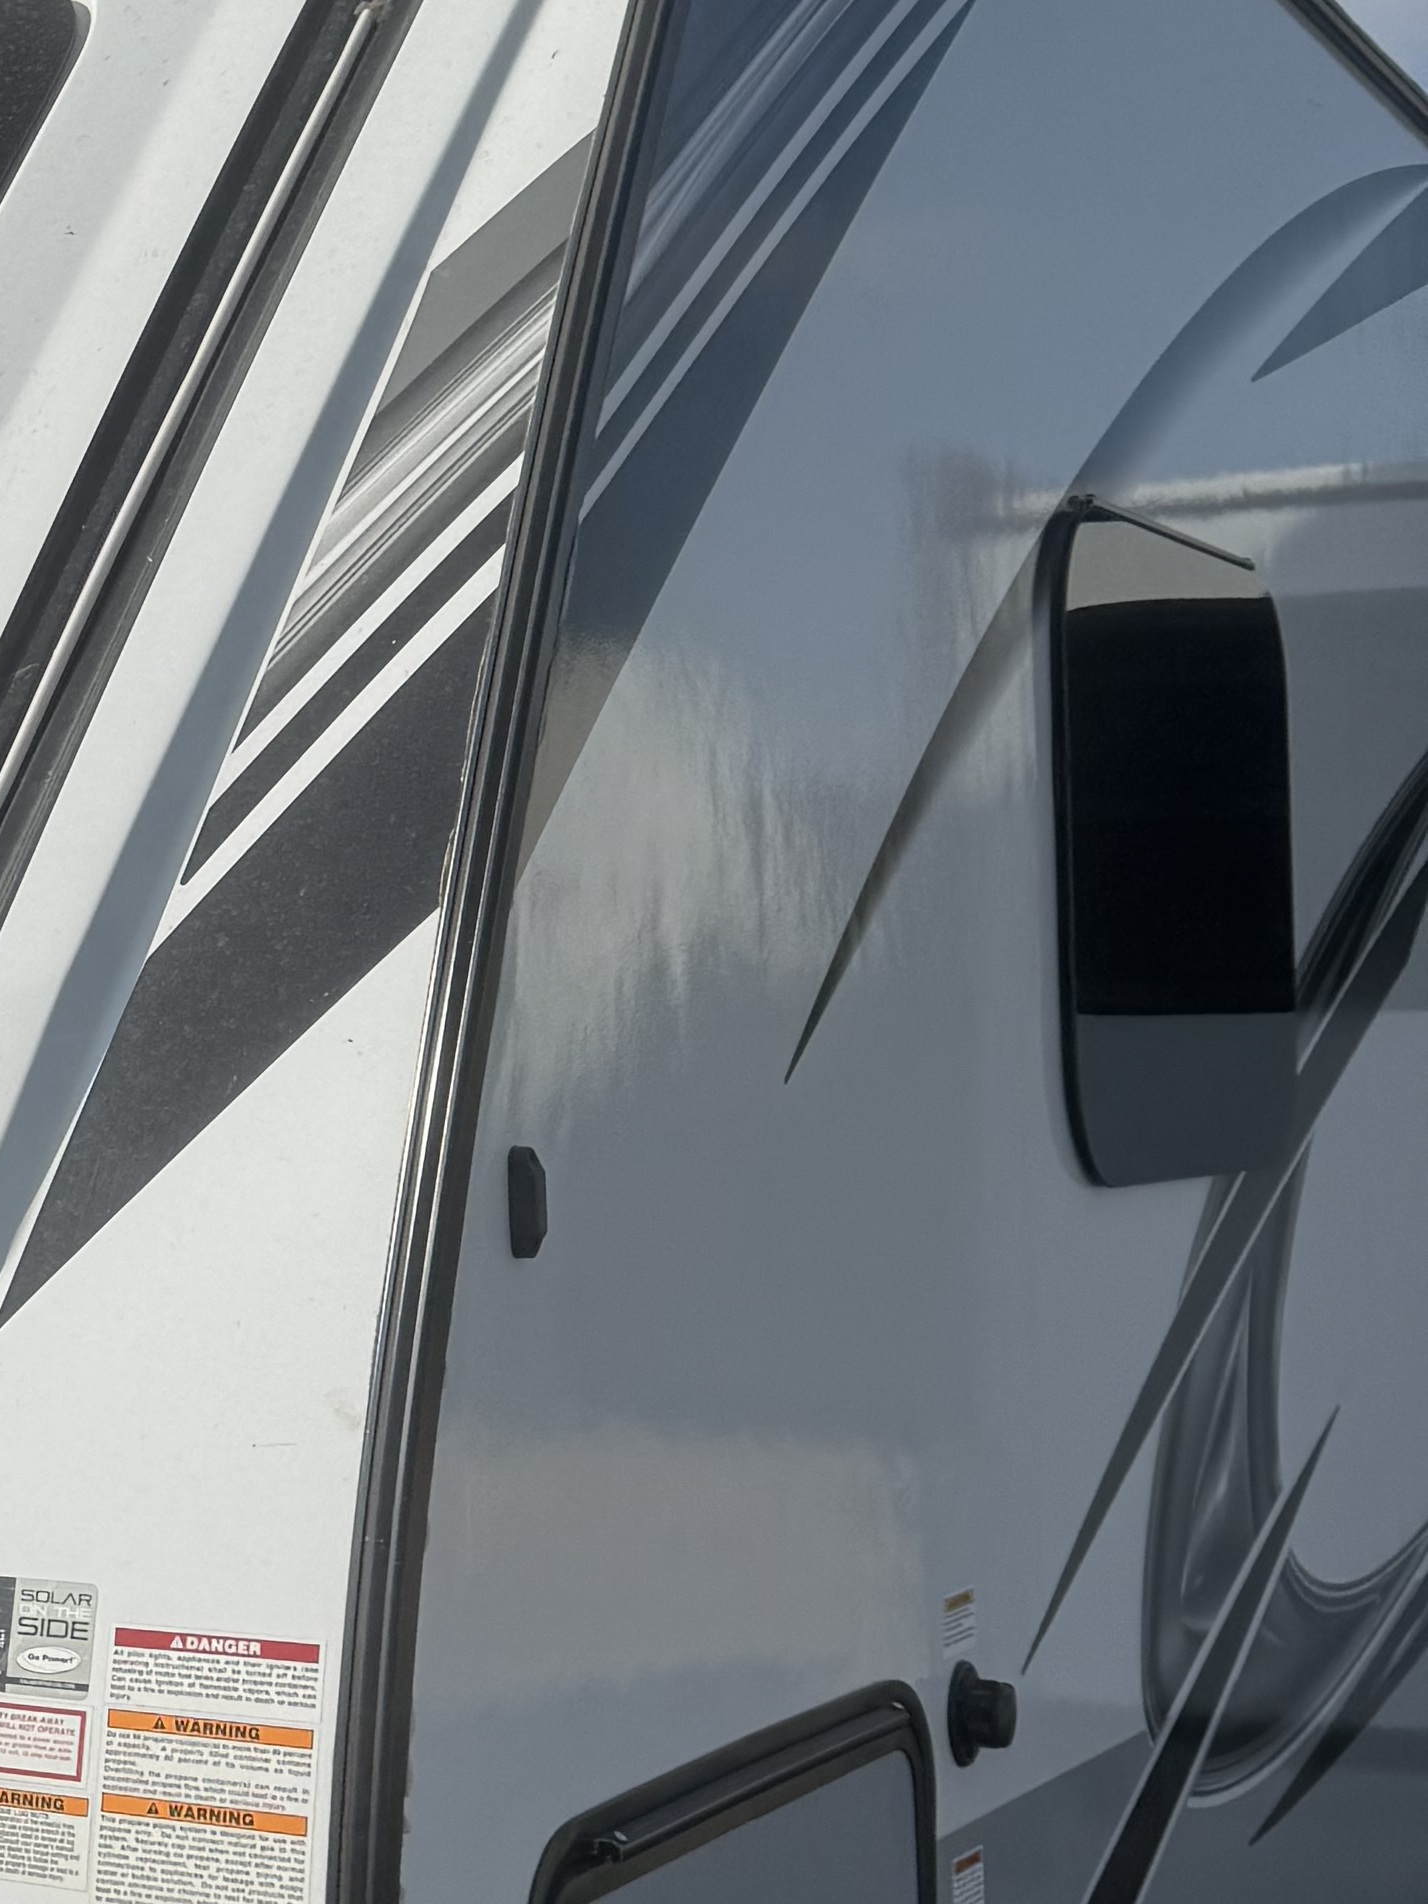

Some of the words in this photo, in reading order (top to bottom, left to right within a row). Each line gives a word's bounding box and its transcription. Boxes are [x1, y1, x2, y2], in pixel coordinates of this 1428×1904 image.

[21, 1589, 92, 1606] SOLAR
[19, 1603, 47, 1616] ON
[54, 1606, 92, 1619] THE
[17, 1616, 90, 1641] SIDE
[186, 1635, 261, 1656] DANGER
[174, 1719, 260, 1740] WARNING
[168, 1804, 254, 1826] WARNING
